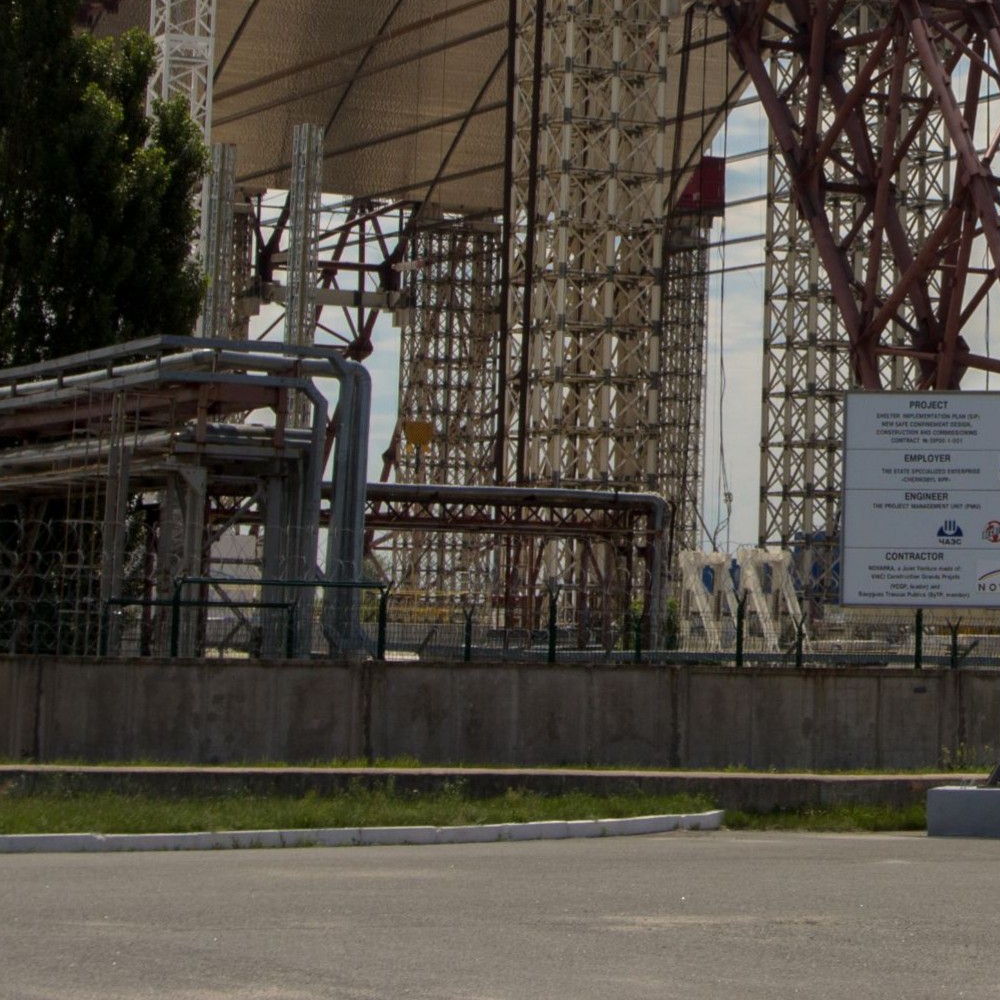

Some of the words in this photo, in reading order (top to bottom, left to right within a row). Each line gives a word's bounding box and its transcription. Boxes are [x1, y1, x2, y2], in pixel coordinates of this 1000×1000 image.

[909, 401, 948, 409] PROJECT
[904, 454, 951, 462] EMPLOYER
[904, 492, 948, 500] ENGINEER
[885, 552, 944, 561] CONTRACTOR
